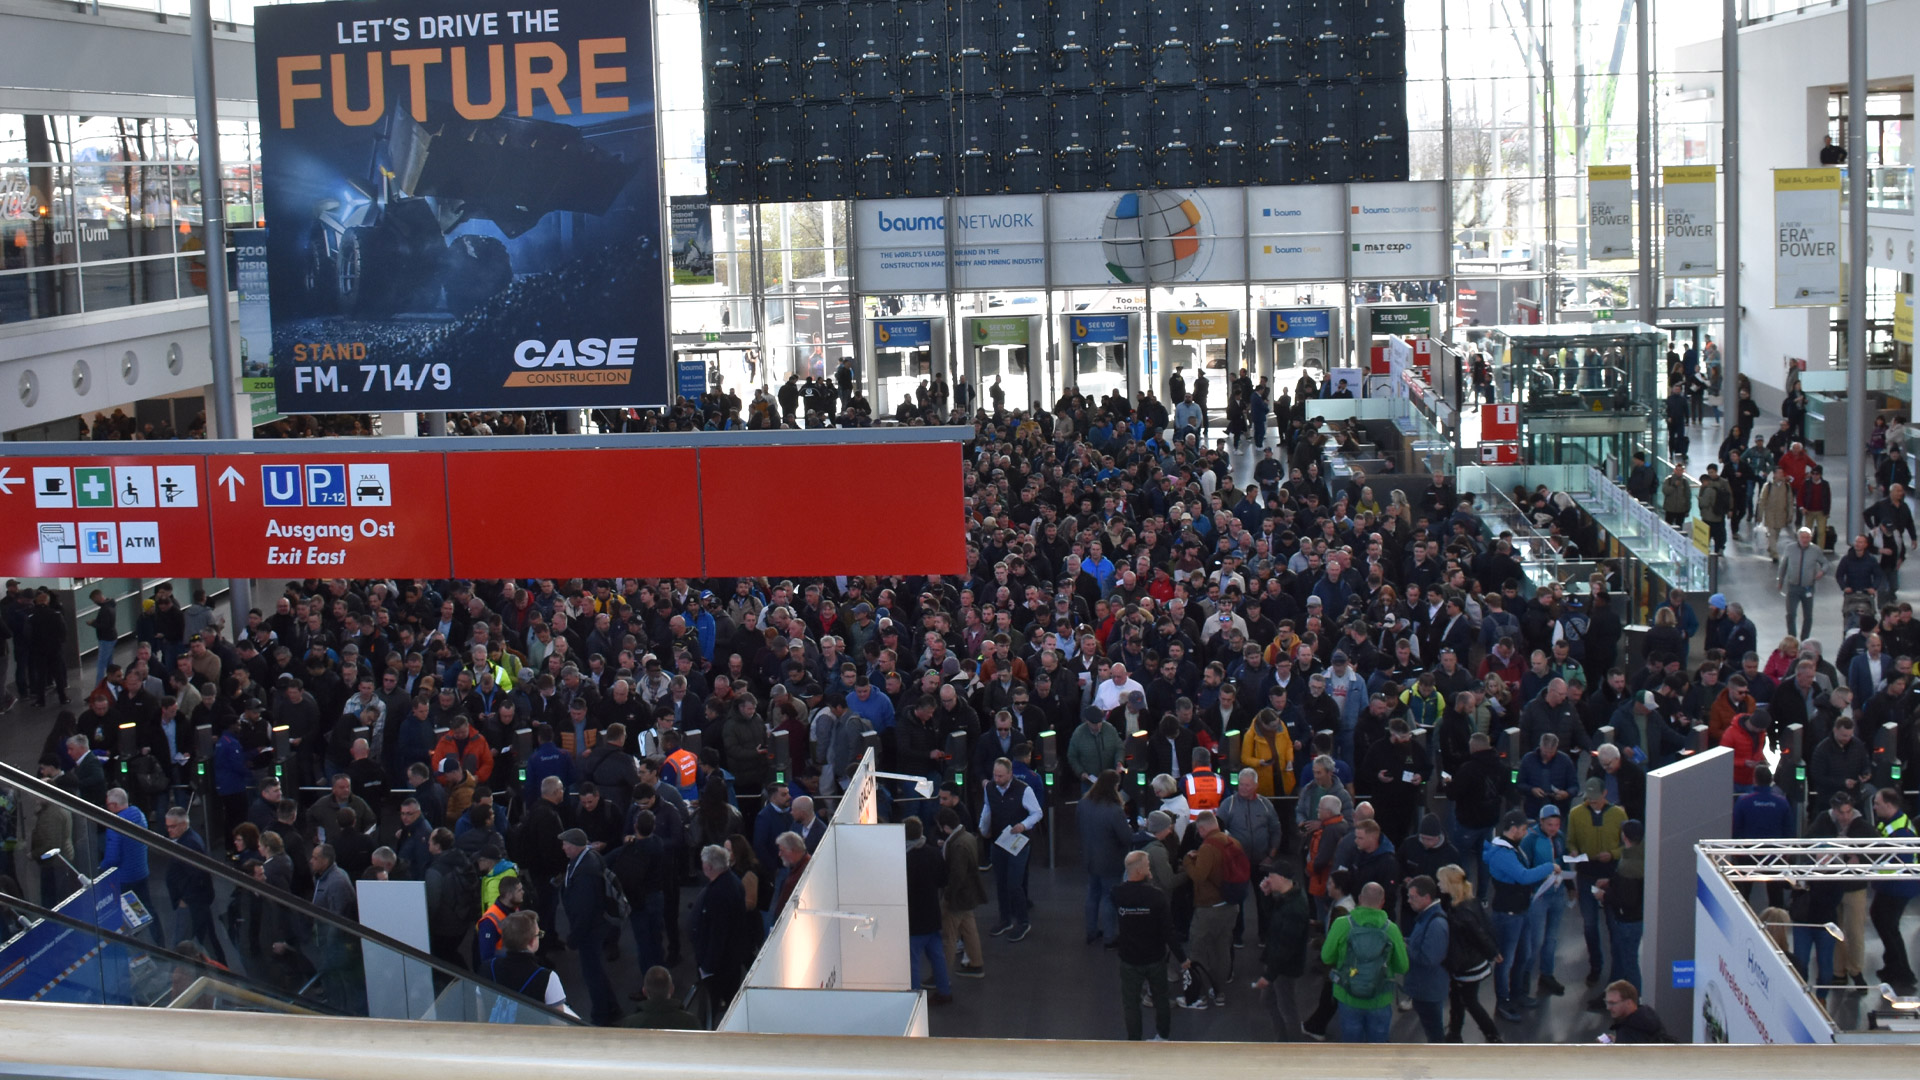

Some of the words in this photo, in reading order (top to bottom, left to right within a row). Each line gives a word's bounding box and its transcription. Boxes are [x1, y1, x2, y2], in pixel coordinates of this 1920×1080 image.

[337, 17, 410, 44] LET'S
[419, 13, 499, 39] DRIVE
[507, 9, 560, 33] THE
[277, 37, 630, 129] FUTURE
[1274, 208, 1302, 216] bauma
[1362, 206, 1390, 214] bauma
[1592, 206, 1611, 216] ERA
[958, 213, 1034, 230] NETWORK
[1592, 215, 1630, 226] POWER
[1667, 214, 1691, 226] ERA
[53, 230, 74, 244] am
[80, 222, 109, 242] Turm
[1667, 225, 1713, 237] POWER
[1780, 228, 1809, 242] ERA
[237, 246, 267, 256] ZOO
[1275, 246, 1302, 254] bauma
[1780, 242, 1836, 257] POWER
[294, 342, 366, 362] STAND
[514, 338, 638, 368] CASE
[295, 366, 348, 393] FM.
[360, 362, 452, 392] 714/9
[526, 372, 627, 384] CONSTRUCTION
[254, 382, 275, 390] ZOO
[270, 471, 294, 500] U
[308, 468, 332, 502] P
[321, 492, 345, 502] 7-12
[266, 519, 354, 542] Ausgang
[360, 518, 396, 538] Ost
[42, 534, 65, 544] News
[125, 537, 155, 548] ATM
[267, 546, 303, 564] Exit
[306, 546, 347, 564] East
[1718, 954, 1744, 1006] Wireless
[1744, 994, 1770, 1044] Remote
